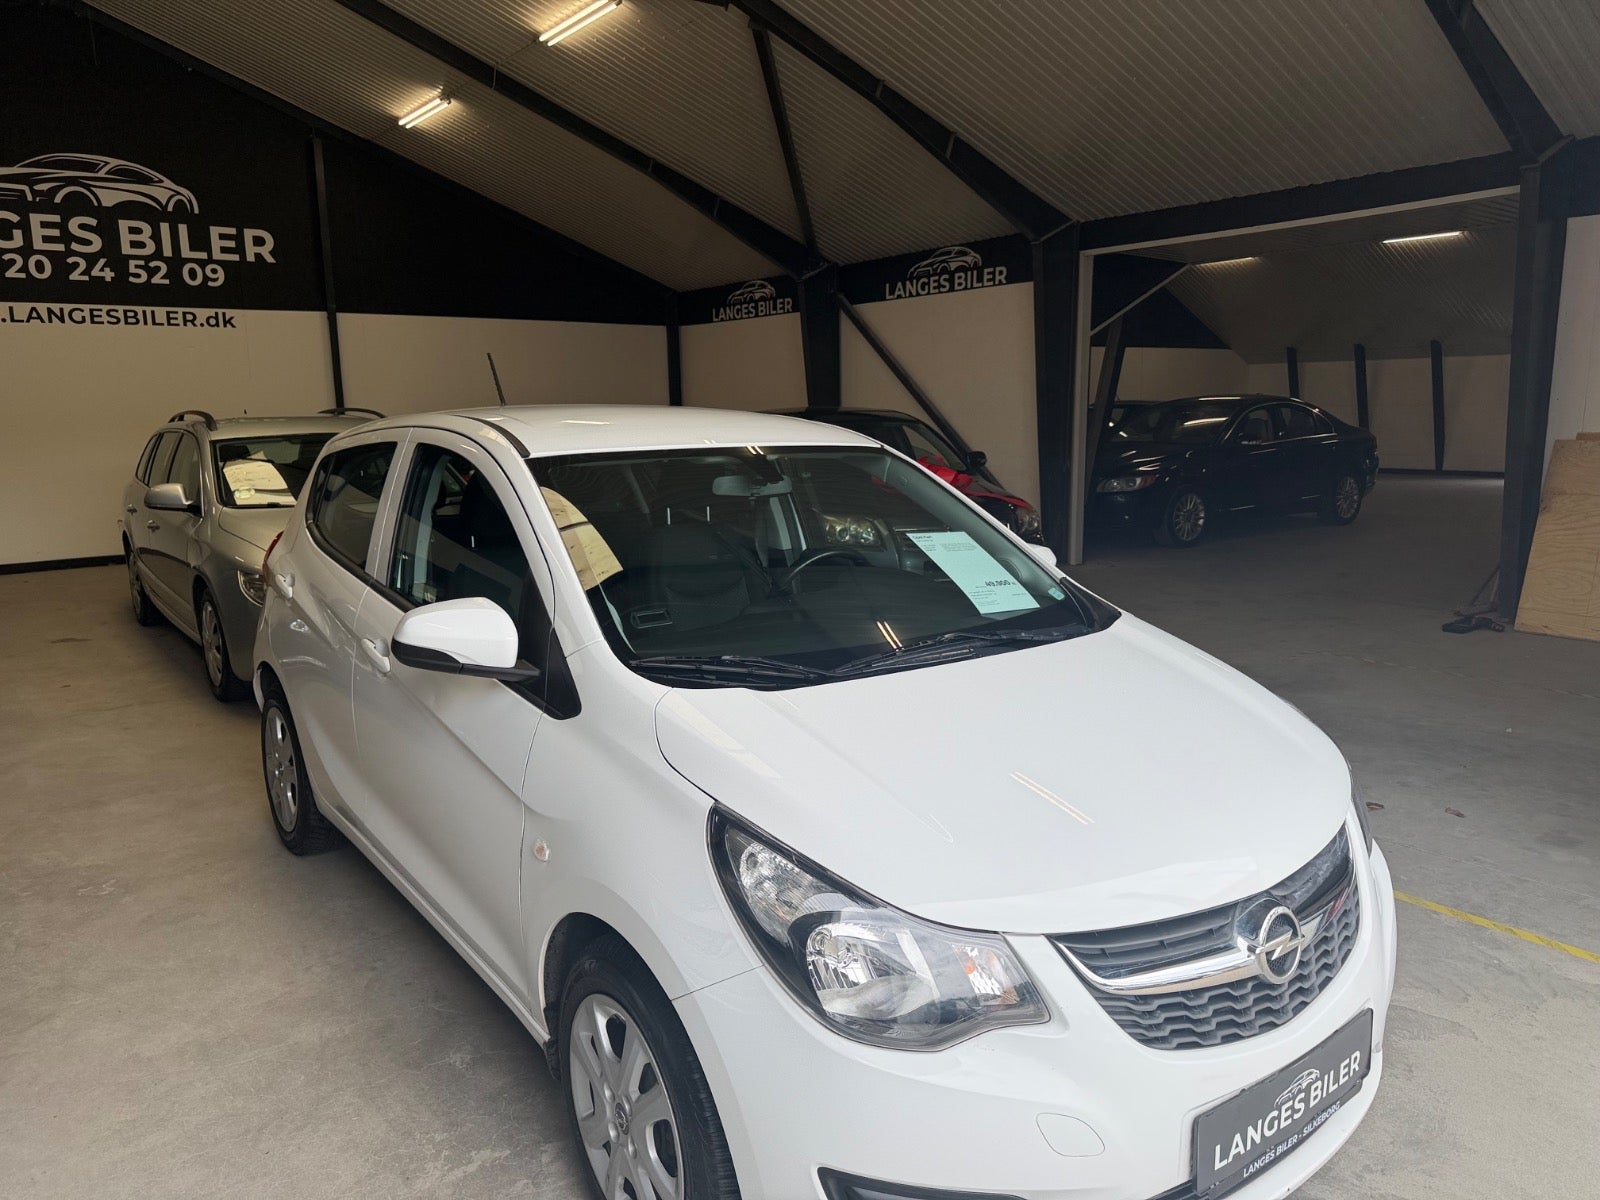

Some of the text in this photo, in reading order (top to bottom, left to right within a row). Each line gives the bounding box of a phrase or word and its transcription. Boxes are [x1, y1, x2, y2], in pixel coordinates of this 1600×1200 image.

[118, 219, 277, 264] BILER
[1, 252, 225, 288] 20 24 52 09
[885, 266, 1008, 300] LANGES BILER
[1, 305, 237, 329] .LANGESBILER.dk
[712, 297, 793, 322] LANGES BILER
[1214, 1050, 1361, 1171] LANGES BILER
[1243, 1148, 1275, 1178] LANGES
[1275, 1134, 1299, 1156] BILER
[1302, 1101, 1341, 1137] SILKEBORG
